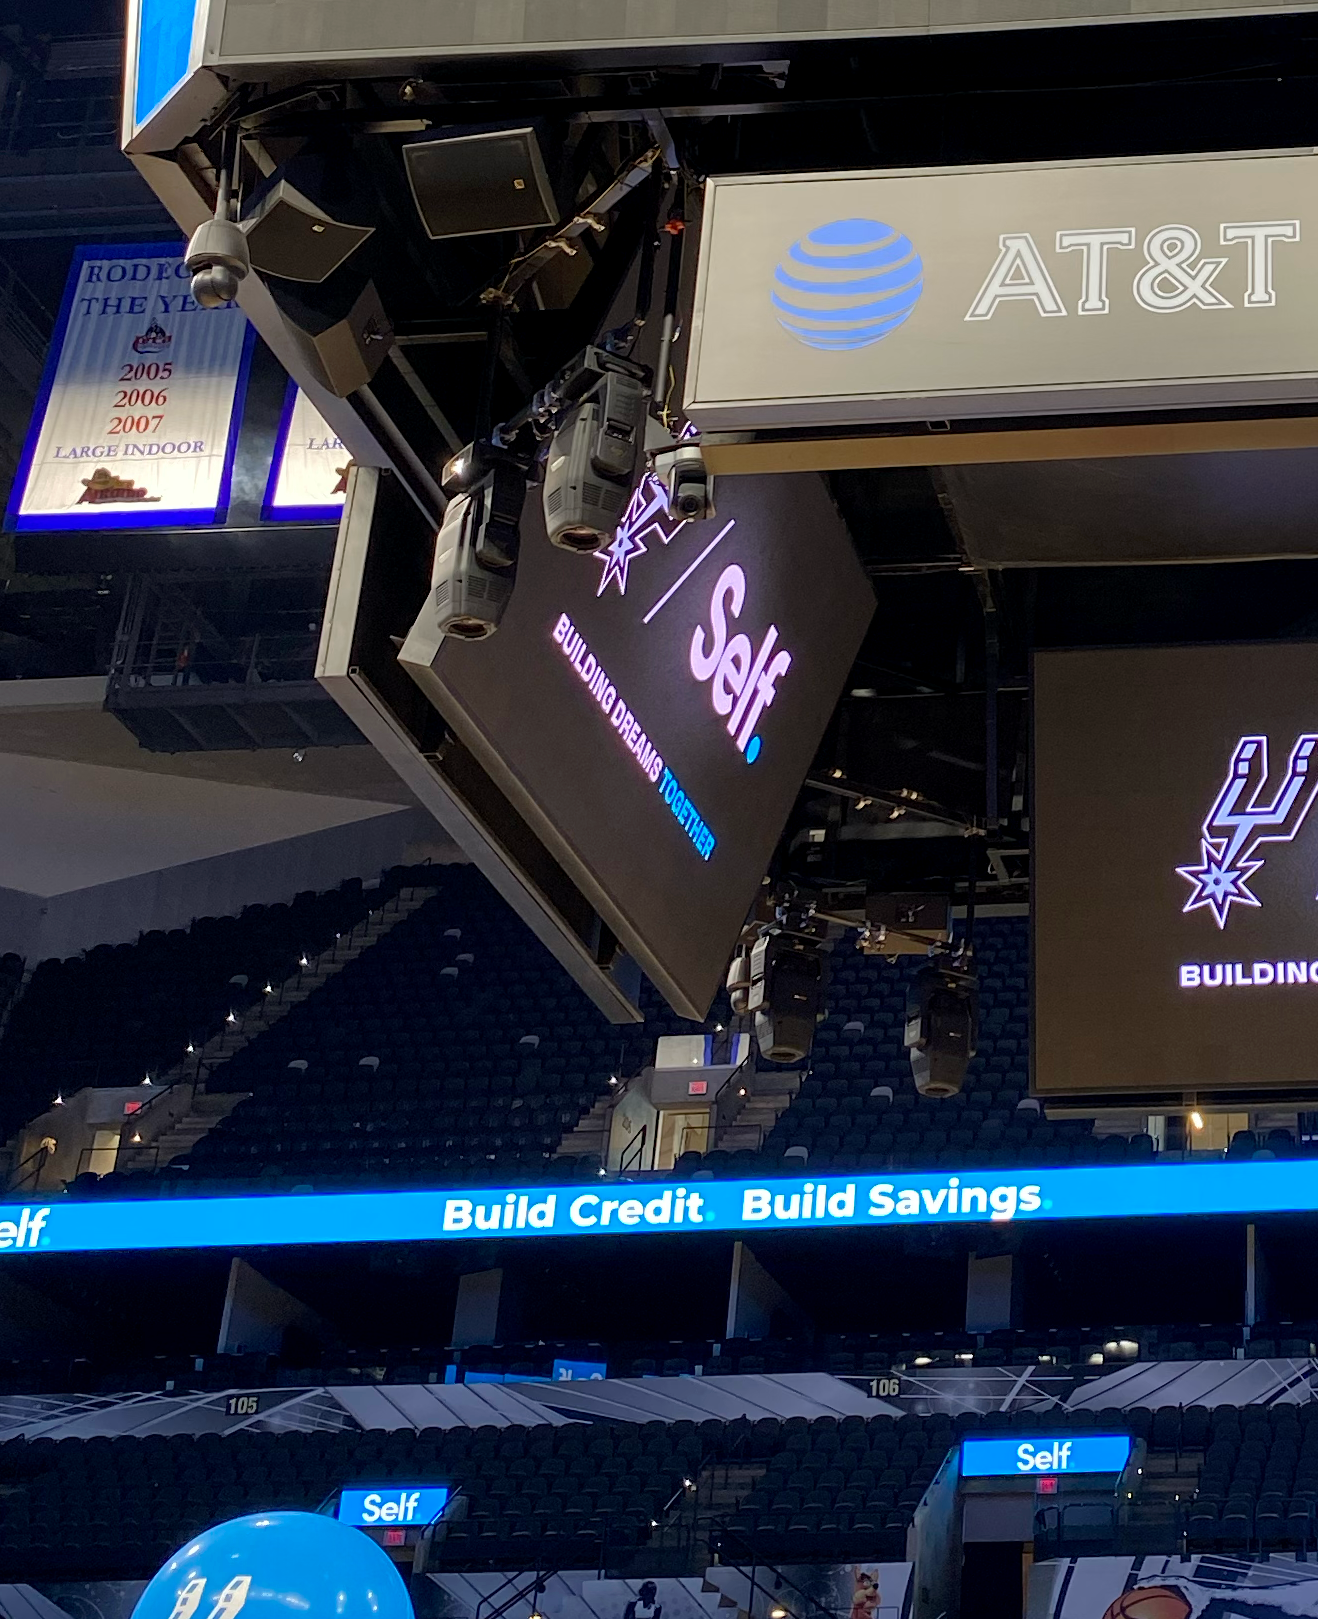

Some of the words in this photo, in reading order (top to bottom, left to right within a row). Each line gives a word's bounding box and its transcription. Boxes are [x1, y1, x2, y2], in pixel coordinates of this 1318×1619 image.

[963, 219, 1301, 321] AT&T
[80, 295, 148, 316] THE
[118, 361, 173, 382] 2005
[112, 387, 169, 408] 2006
[106, 414, 165, 435] 2007
[53, 444, 119, 459] LARGE
[122, 440, 205, 456] INDOOR
[552, 612, 617, 714] BUILDING
[610, 698, 664, 783] DREAMS
[658, 766, 716, 861] TOGETHER
[442, 1193, 557, 1231] Build
[742, 1182, 857, 1221] Build
[868, 1377, 900, 1398] 106
[228, 1395, 258, 1415] 105
